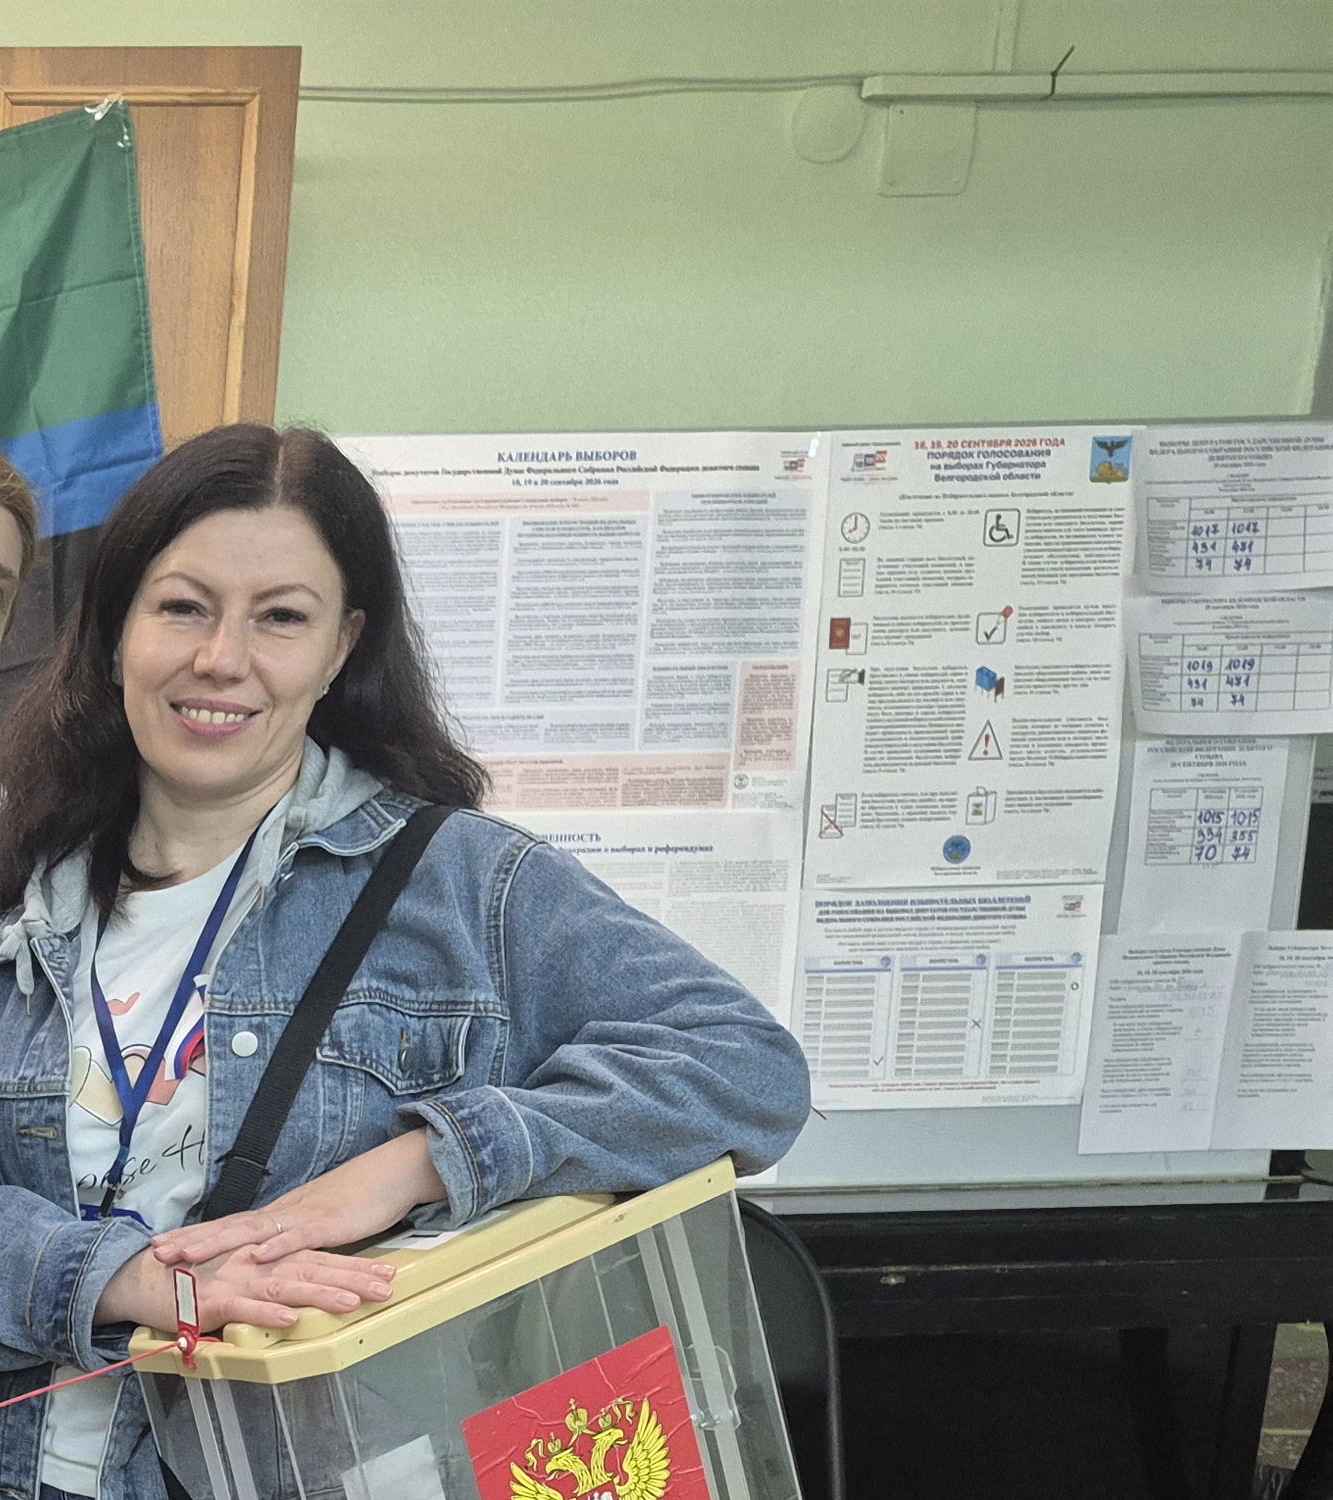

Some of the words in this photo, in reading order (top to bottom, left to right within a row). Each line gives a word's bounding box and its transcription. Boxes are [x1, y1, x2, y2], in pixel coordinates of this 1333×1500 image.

[497, 451, 573, 464] КАЛЕНДАРЬ
[576, 449, 638, 462] ВЫБОРОВ
[927, 450, 975, 460] ПОРЯДОК
[977, 449, 1051, 459] ГОЛОСОВАНИЯ
[930, 463, 942, 471] на
[944, 461, 983, 471] выборах
[986, 460, 1046, 471] Губернатора
[934, 472, 1001, 482] Белгородской
[1002, 471, 1042, 481] области
[1198, 810, 1225, 825] 1015
[1231, 808, 1260, 826] 1015
[1195, 844, 1217, 862] 70
